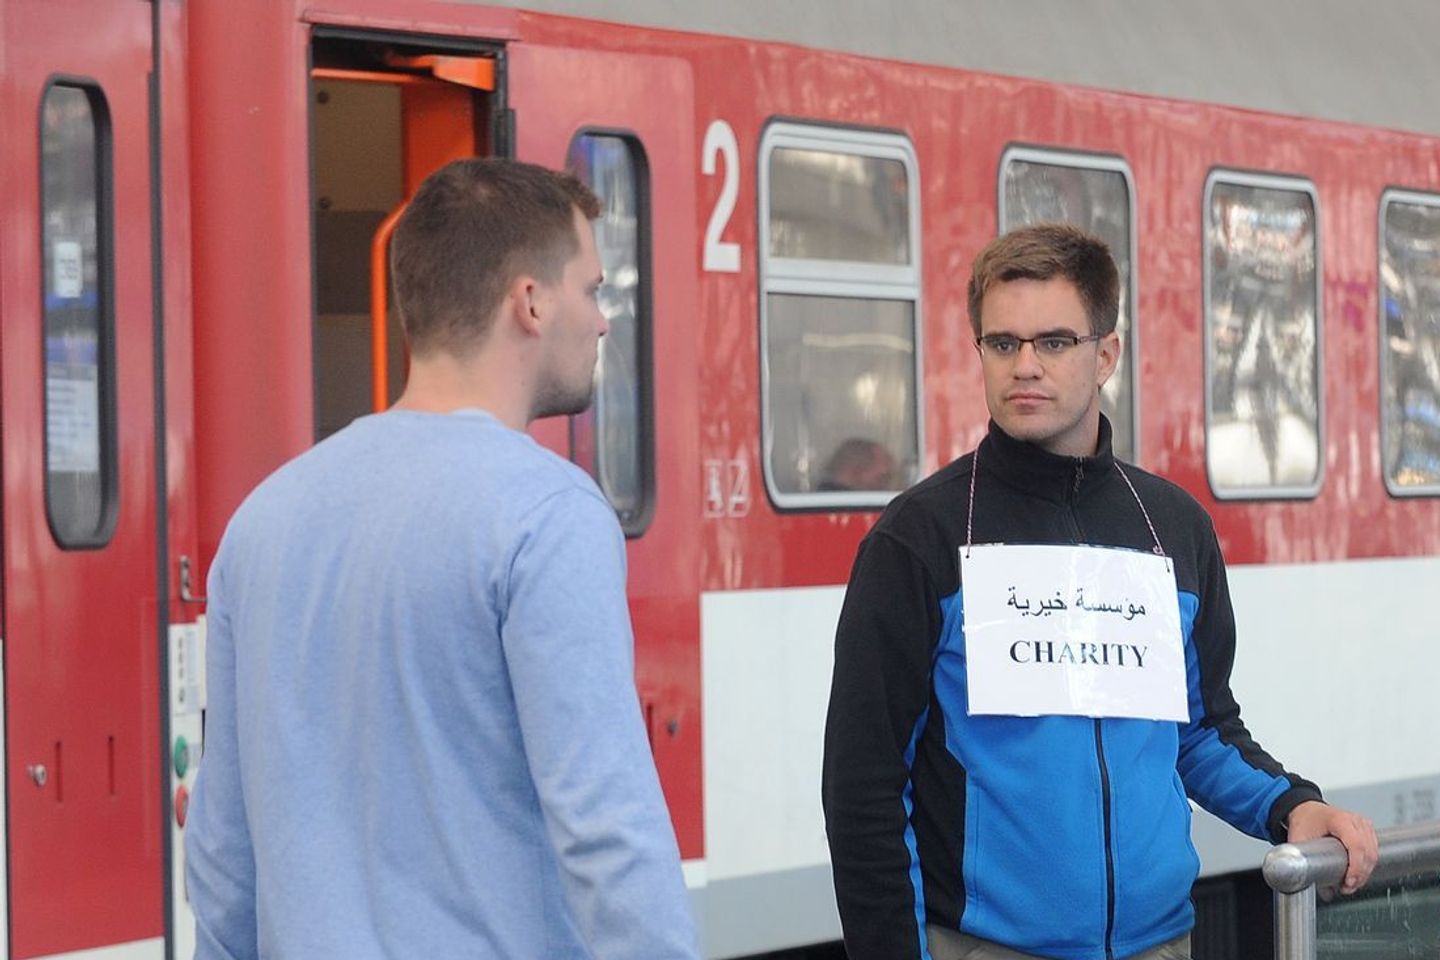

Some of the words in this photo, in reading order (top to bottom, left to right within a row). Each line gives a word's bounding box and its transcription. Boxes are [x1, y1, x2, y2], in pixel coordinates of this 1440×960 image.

[702, 119, 741, 272] 2
[1007, 586, 1068, 617] خيرية
[1009, 640, 1148, 668] CHARITY
